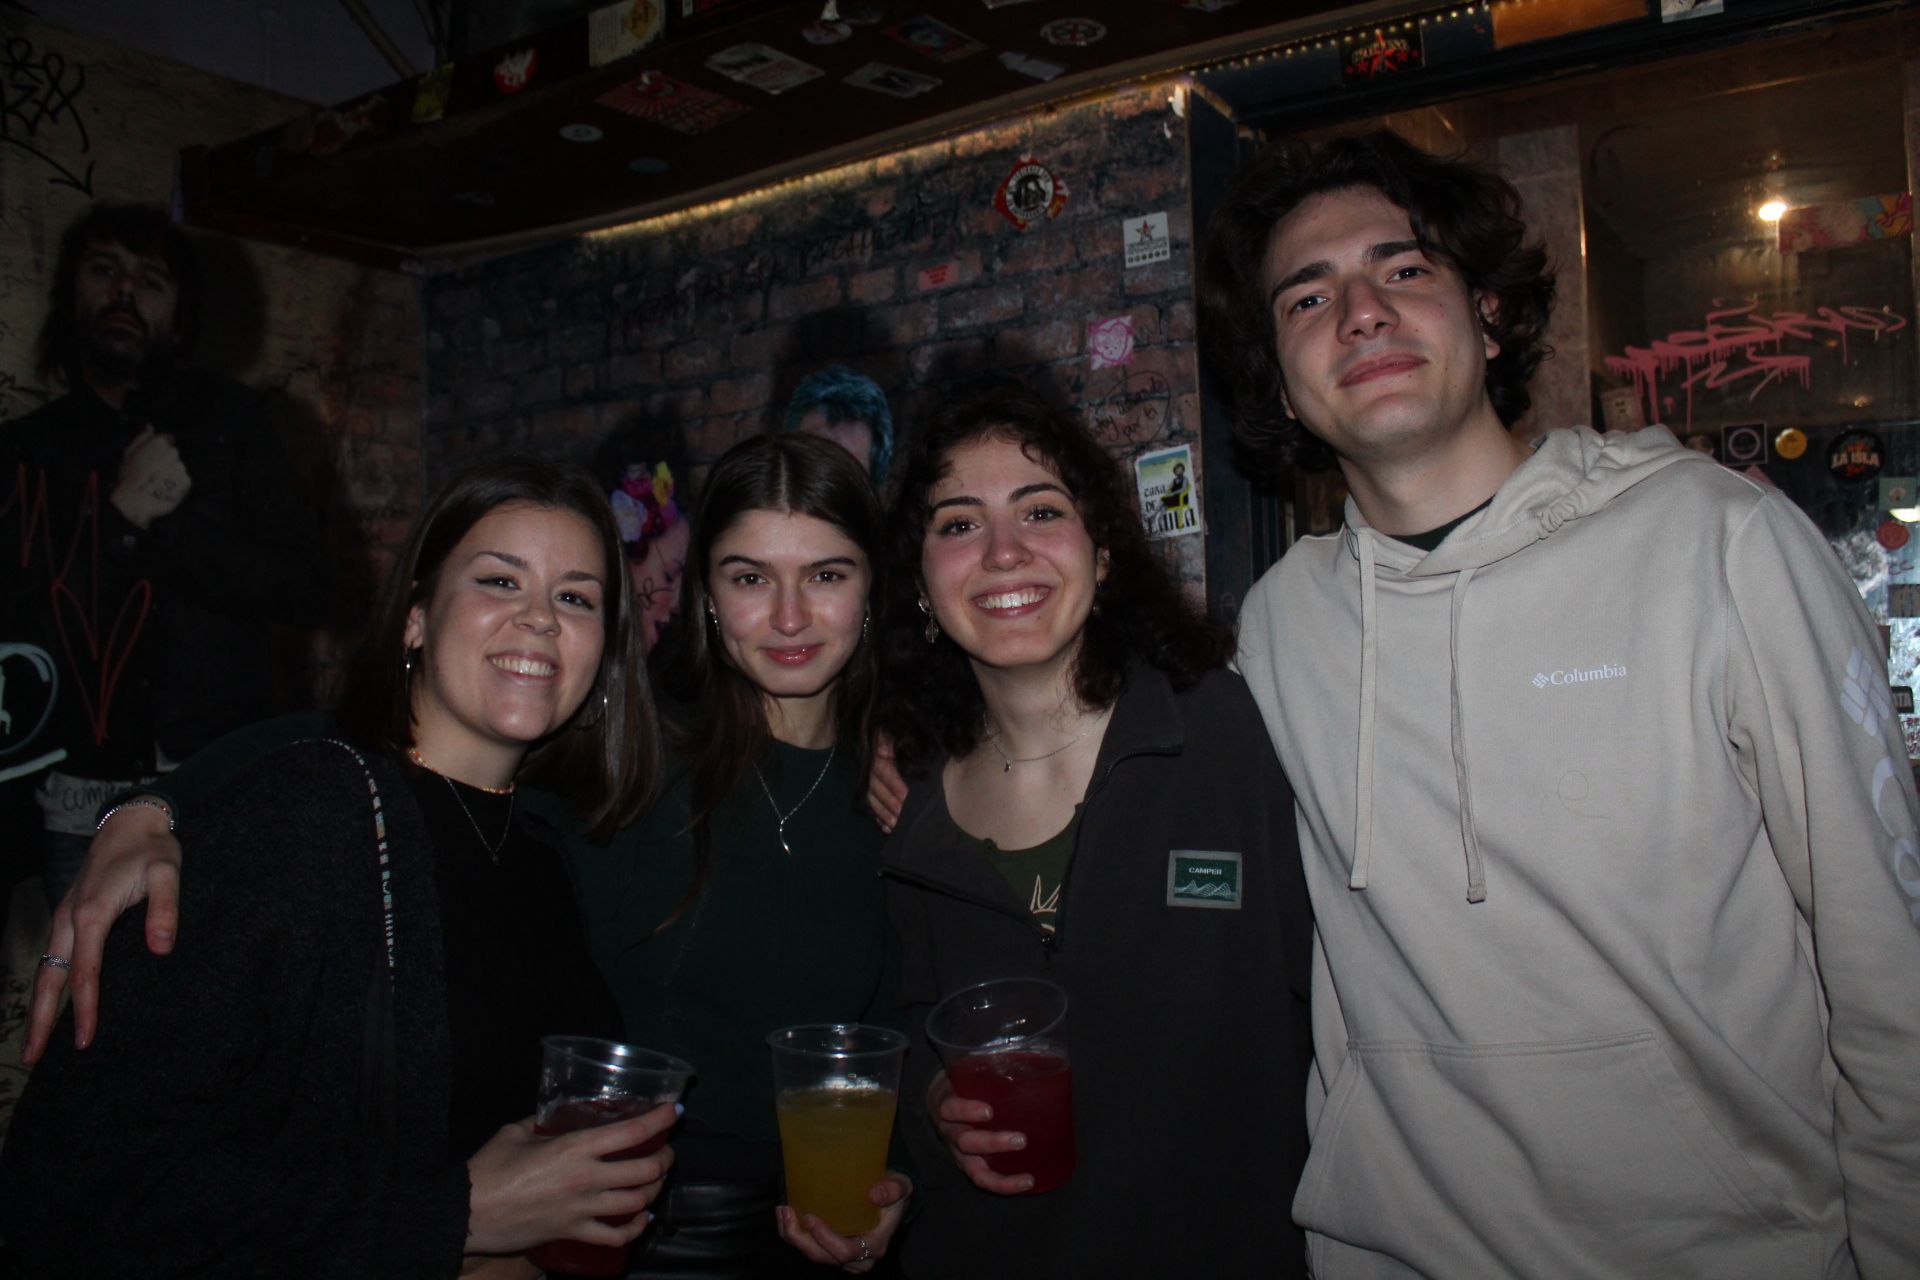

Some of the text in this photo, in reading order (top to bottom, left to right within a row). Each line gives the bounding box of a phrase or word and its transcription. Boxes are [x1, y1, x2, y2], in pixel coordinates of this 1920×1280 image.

[1831, 452, 1848, 469] LA
[1550, 664, 1627, 685] Columbia
[1188, 866, 1222, 875] CAMPER
